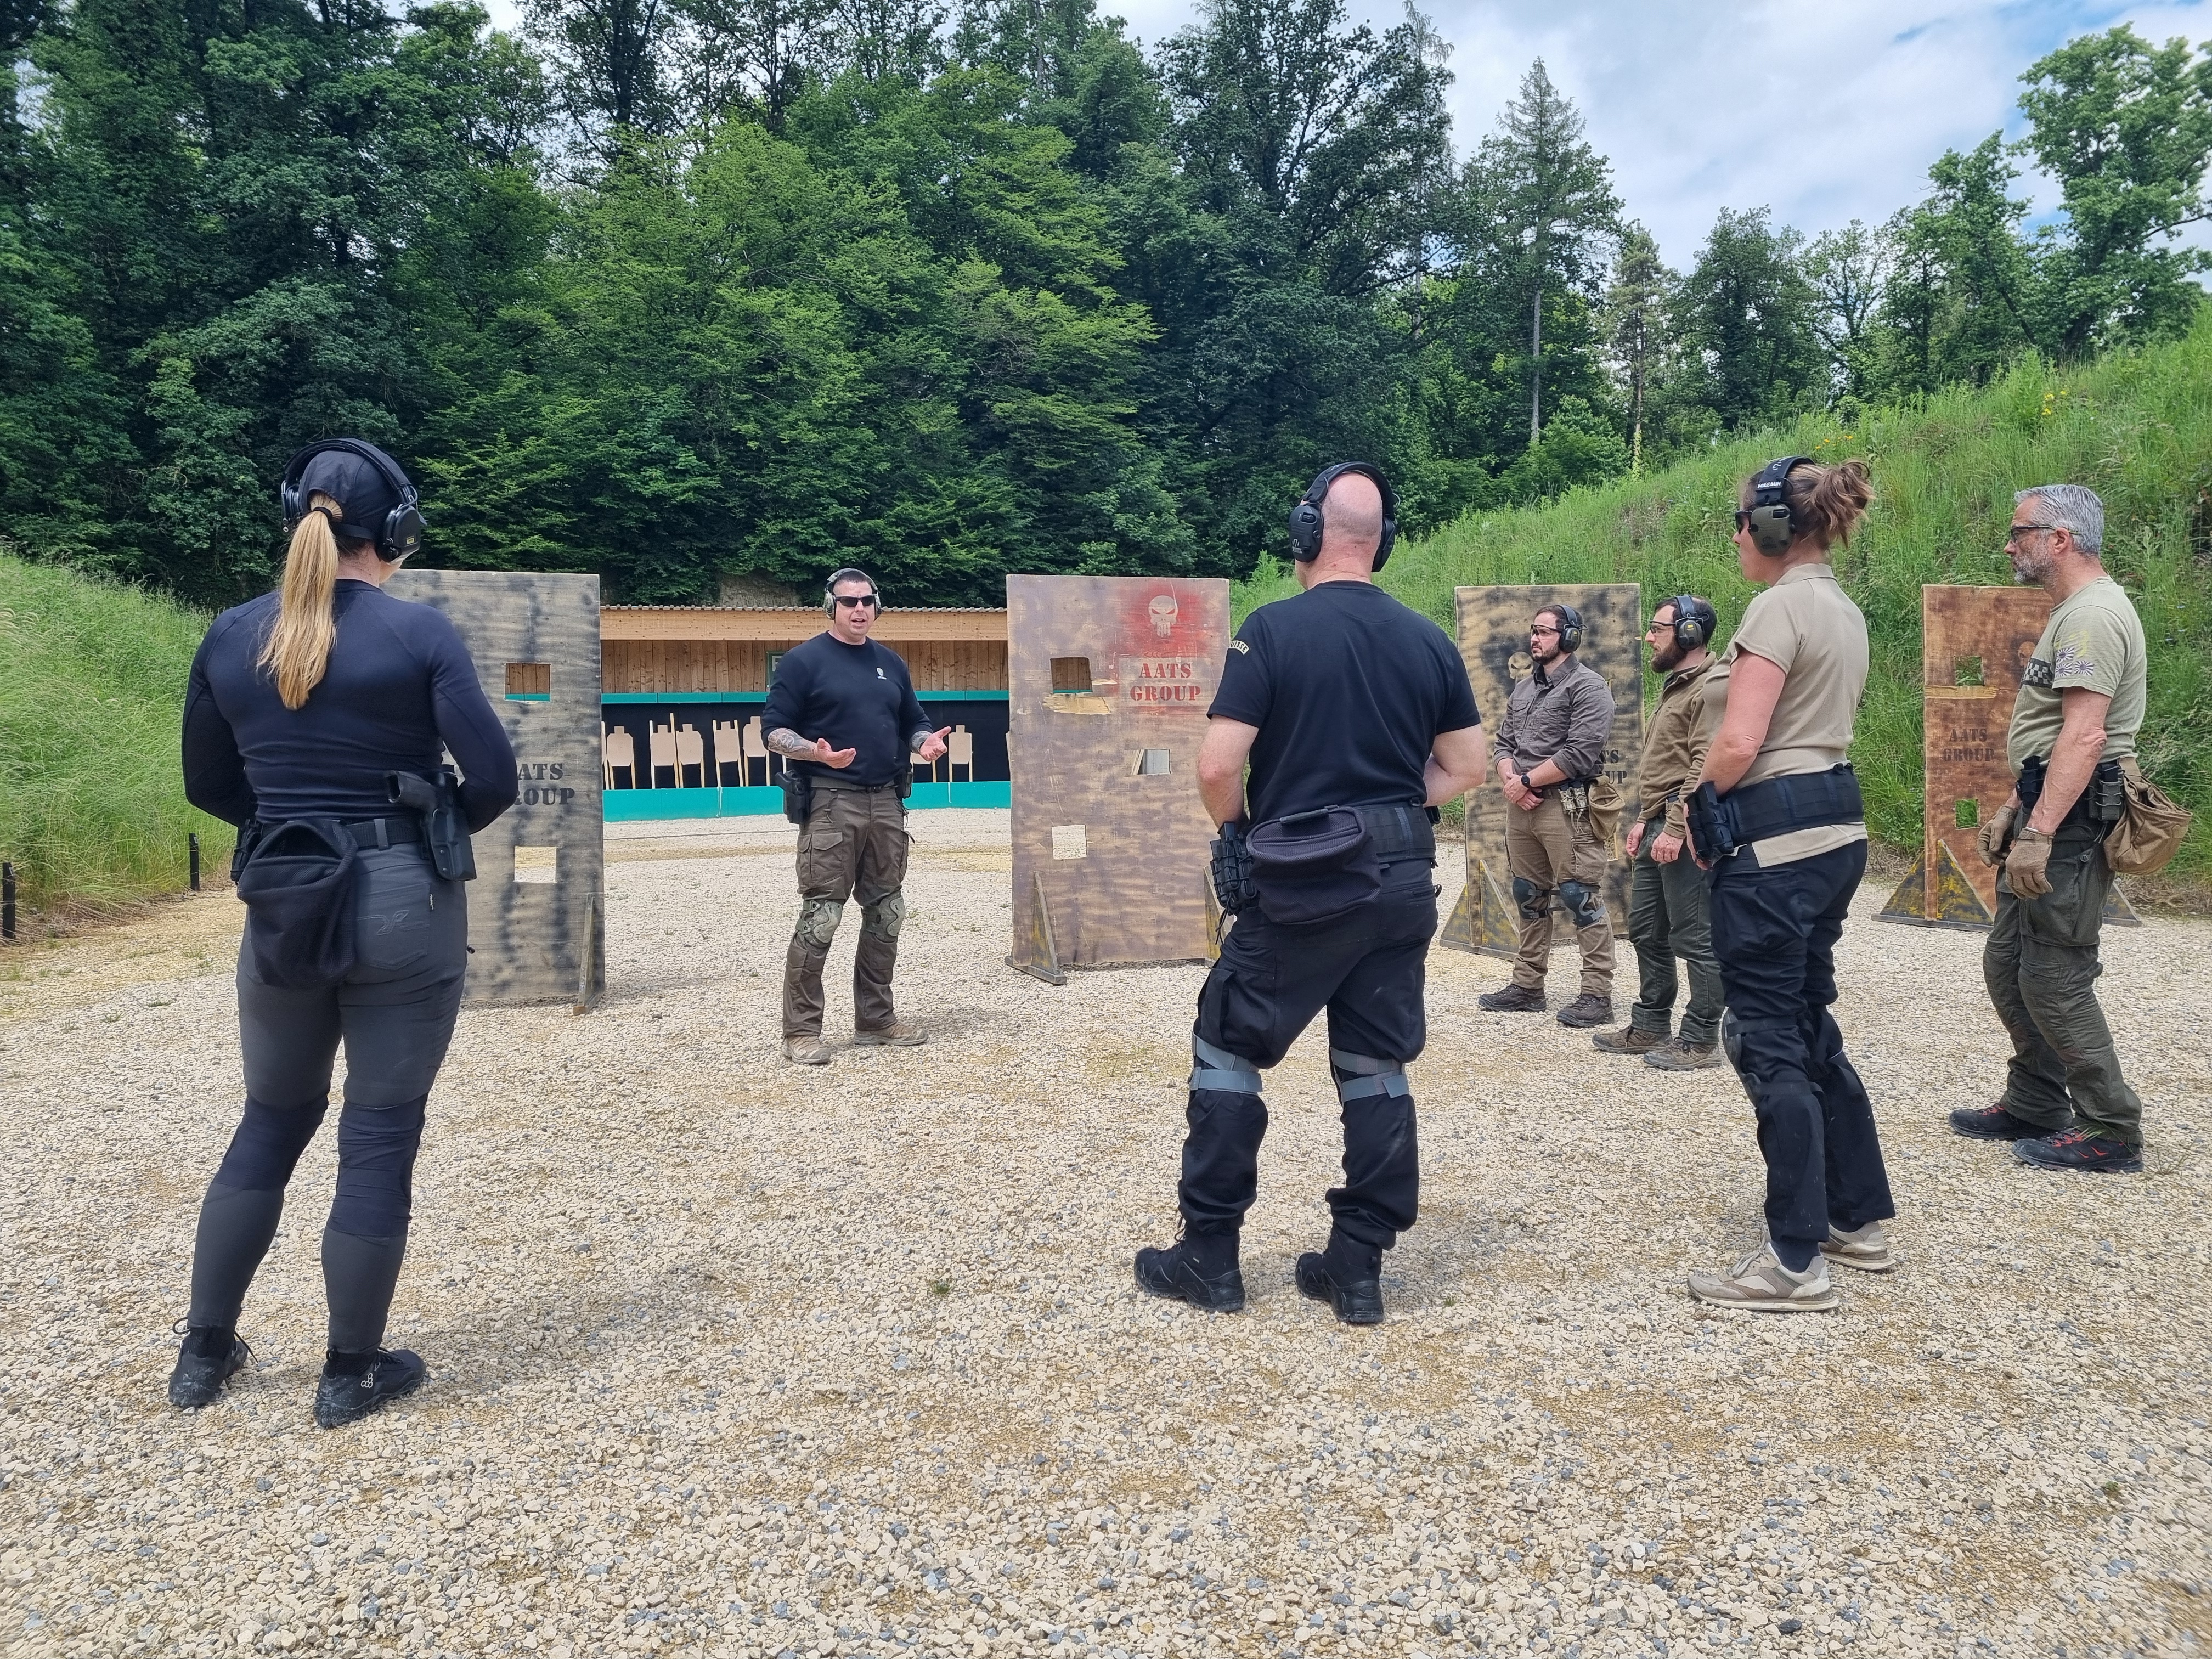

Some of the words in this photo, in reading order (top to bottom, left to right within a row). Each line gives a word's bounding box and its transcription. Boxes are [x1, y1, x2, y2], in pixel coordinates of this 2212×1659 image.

[1230, 641, 1248, 652] UISSE
[1138, 663, 1191, 678] AATS
[1130, 686, 1201, 701] GROUP
[1949, 728, 1987, 742] AATS
[1943, 748, 1995, 761] GROUP
[518, 763, 563, 780] ATS
[514, 788, 575, 805] OUP
